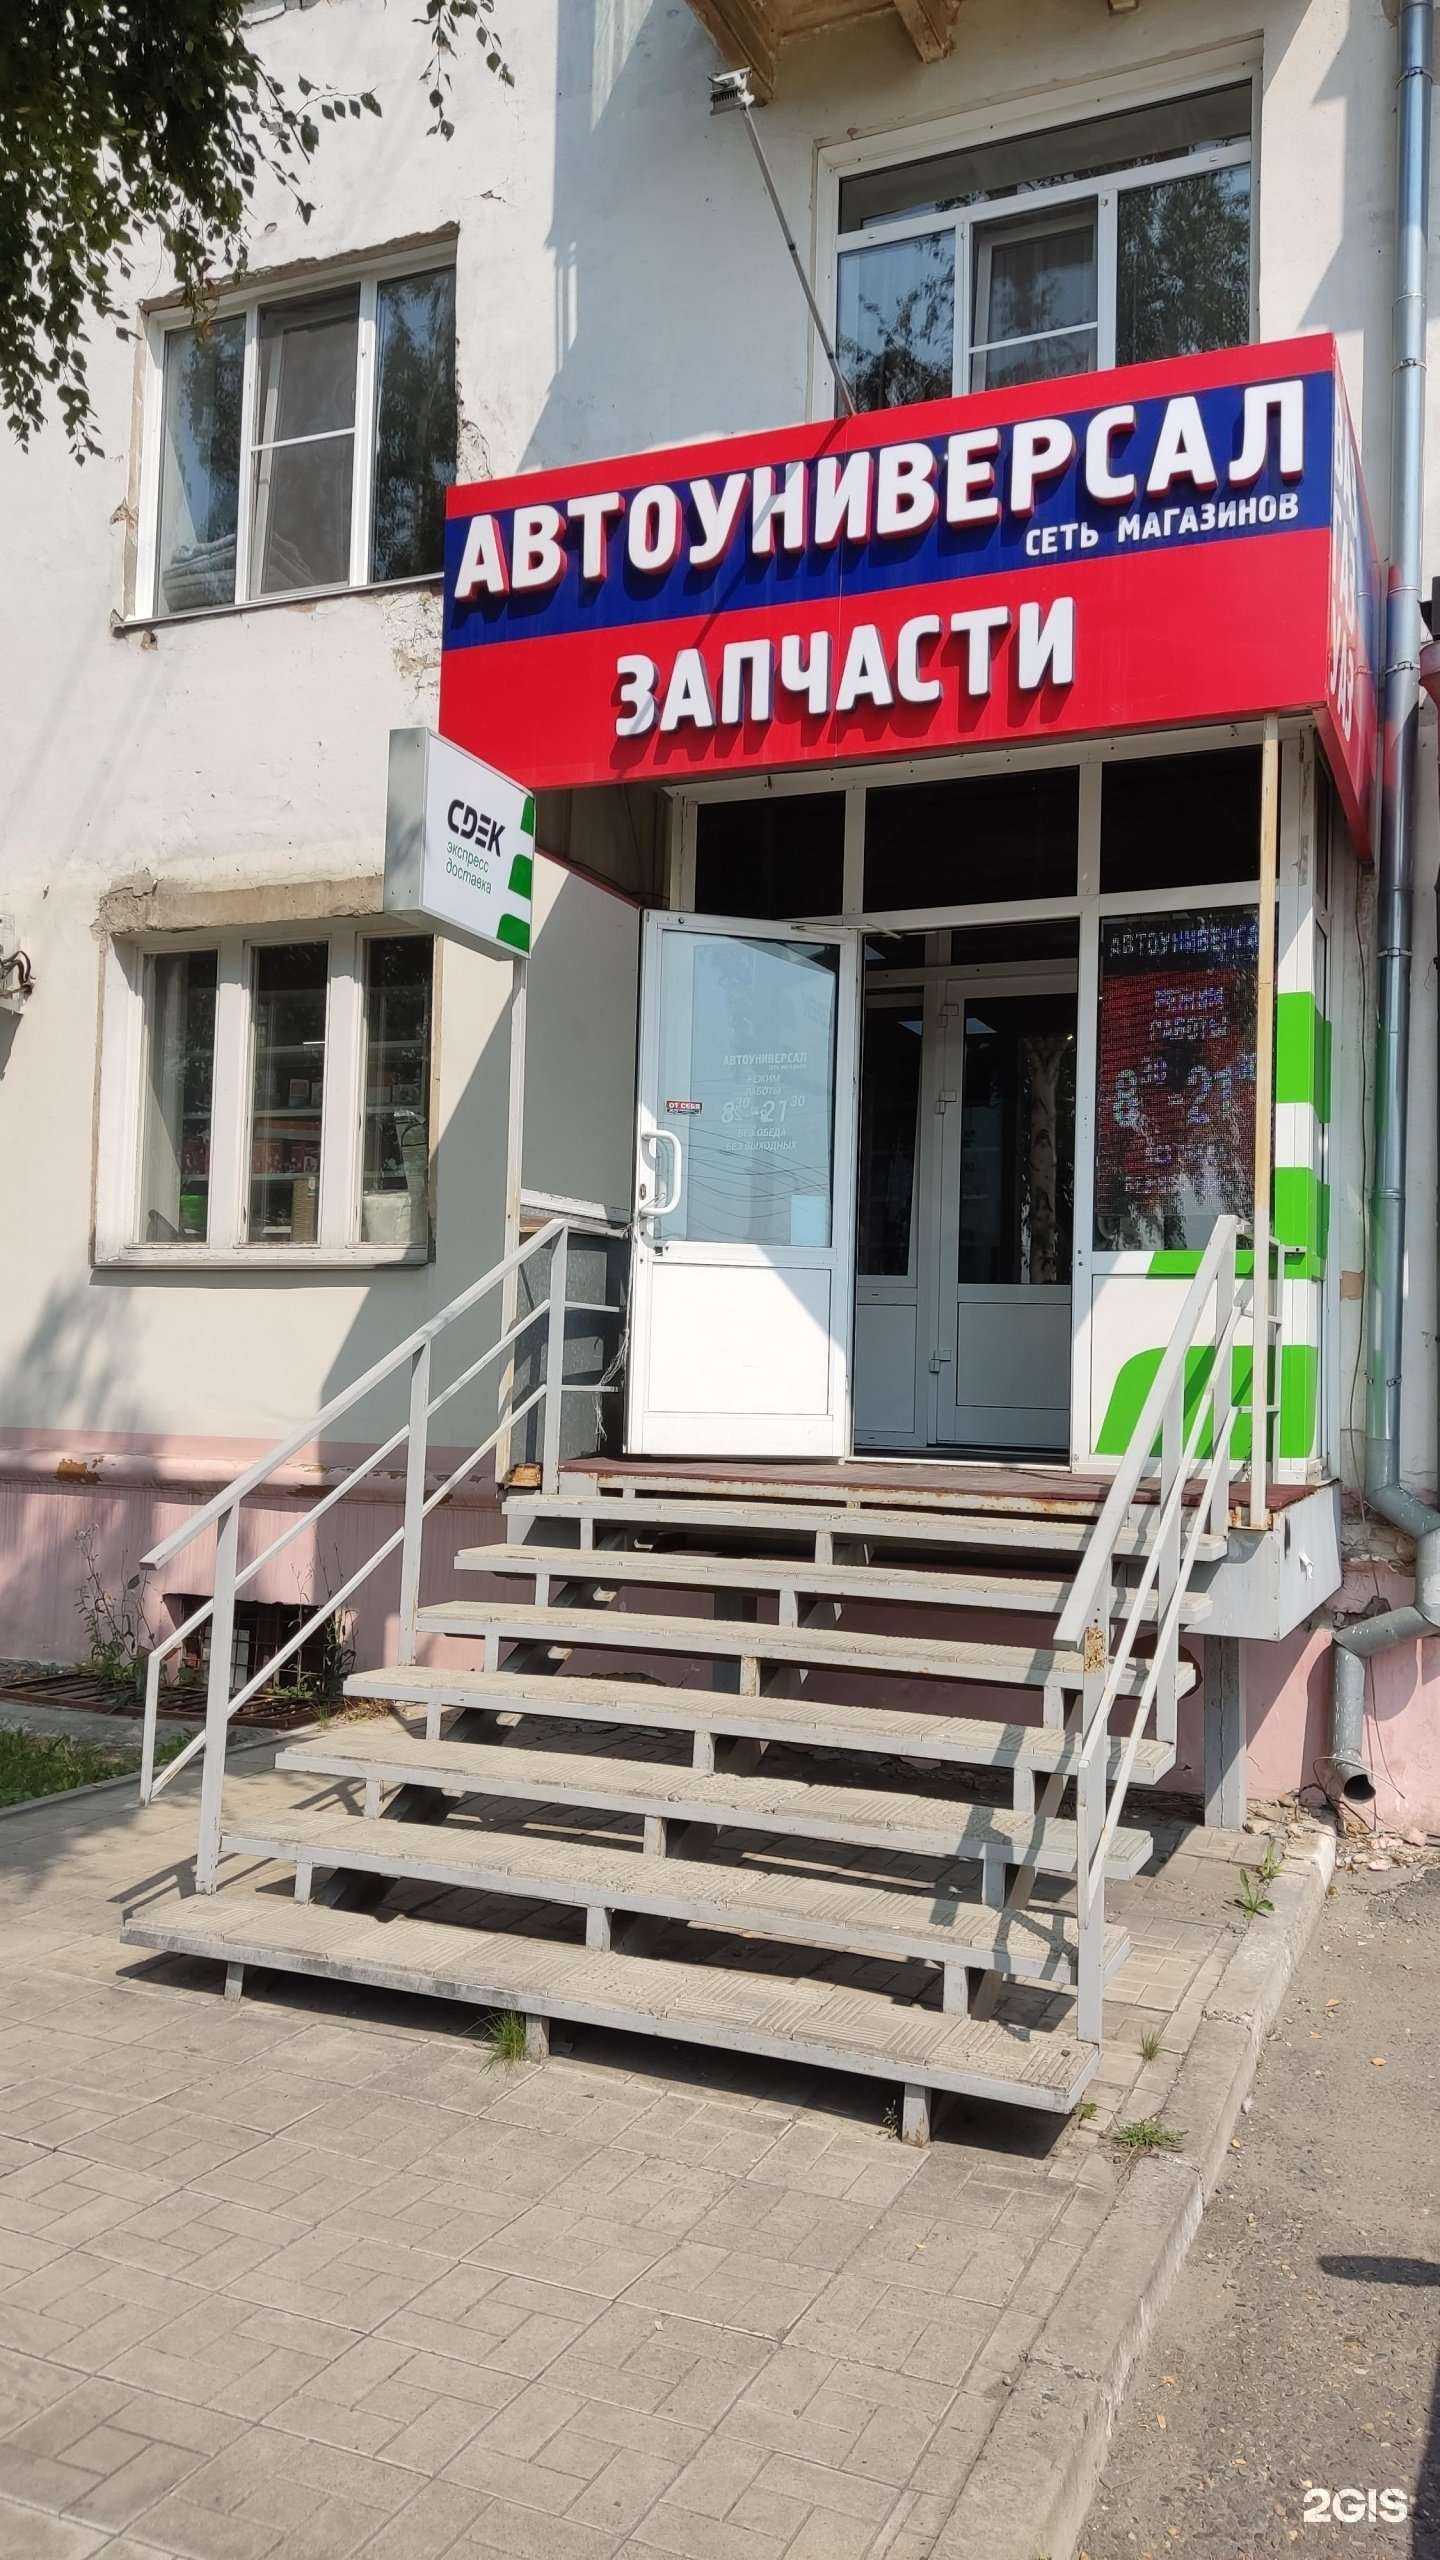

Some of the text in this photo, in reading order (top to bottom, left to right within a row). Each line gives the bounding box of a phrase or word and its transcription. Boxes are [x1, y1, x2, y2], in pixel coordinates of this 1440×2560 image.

[453, 379, 1305, 600] АВТОУНИВЕРСАЛ
[1026, 493, 1300, 556] СЕТЬ МАГАЗИНОВ
[614, 596, 1076, 737] ЗАПЧАСТИ
[447, 799, 506, 857] CDEK
[445, 857, 493, 895] доставка
[446, 841, 490, 874] экспресс
[723, 1052, 808, 1066] АВТОУНИВЕРСАЛ
